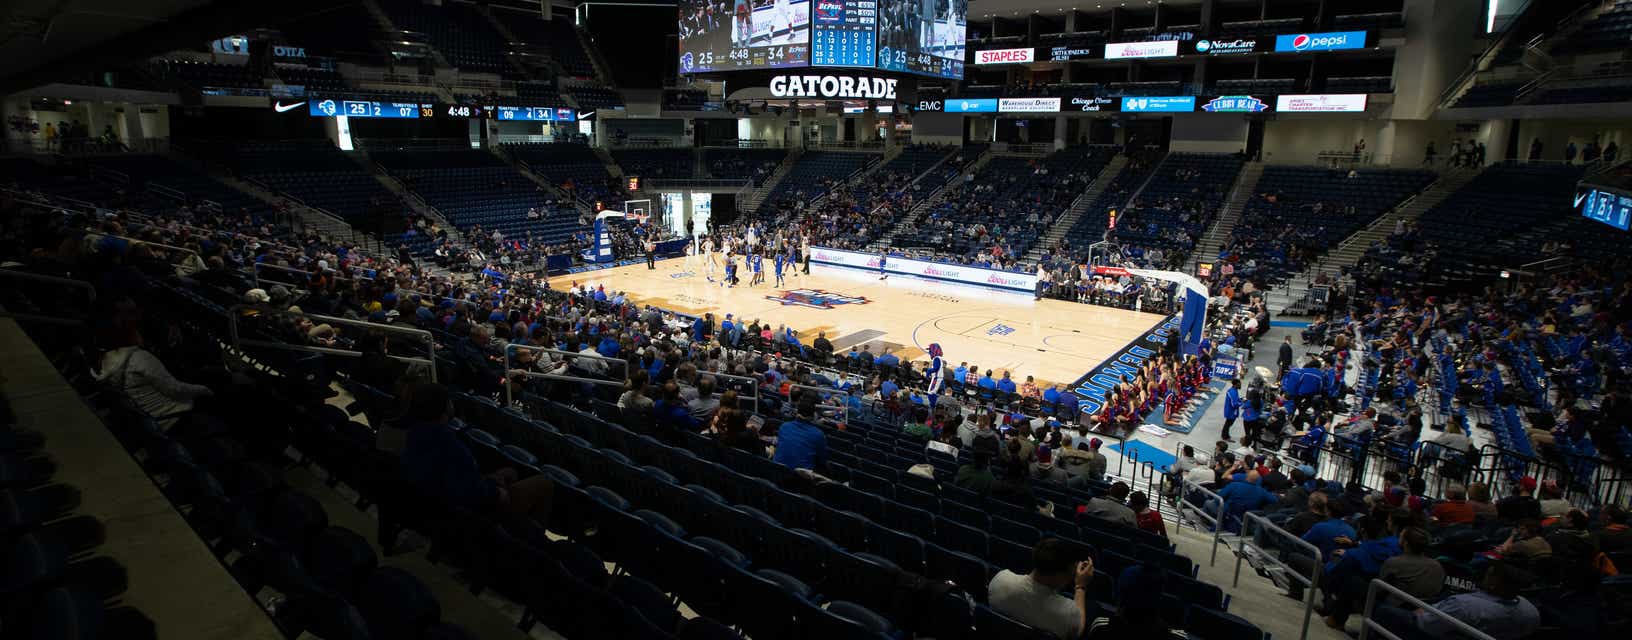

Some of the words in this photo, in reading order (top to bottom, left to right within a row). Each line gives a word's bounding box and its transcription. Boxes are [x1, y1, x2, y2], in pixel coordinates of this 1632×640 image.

[1210, 39, 1256, 49] NovaCare
[1311, 35, 1346, 48] pepsi
[699, 52, 713, 64] 25
[729, 49, 749, 60] 4:48
[768, 47, 784, 59] 34
[895, 50, 906, 64] 25
[942, 58, 952, 70] 34
[982, 50, 1027, 62] STAPLES
[769, 75, 898, 99] GATORADE
[350, 104, 365, 114] 25
[448, 106, 470, 116] 4:48
[919, 101, 941, 111] EMC
[375, 107, 381, 116] 2
[400, 107, 412, 117] 07
[422, 109, 433, 117] 30
[526, 111, 532, 119] 4
[538, 110, 548, 118] 34
